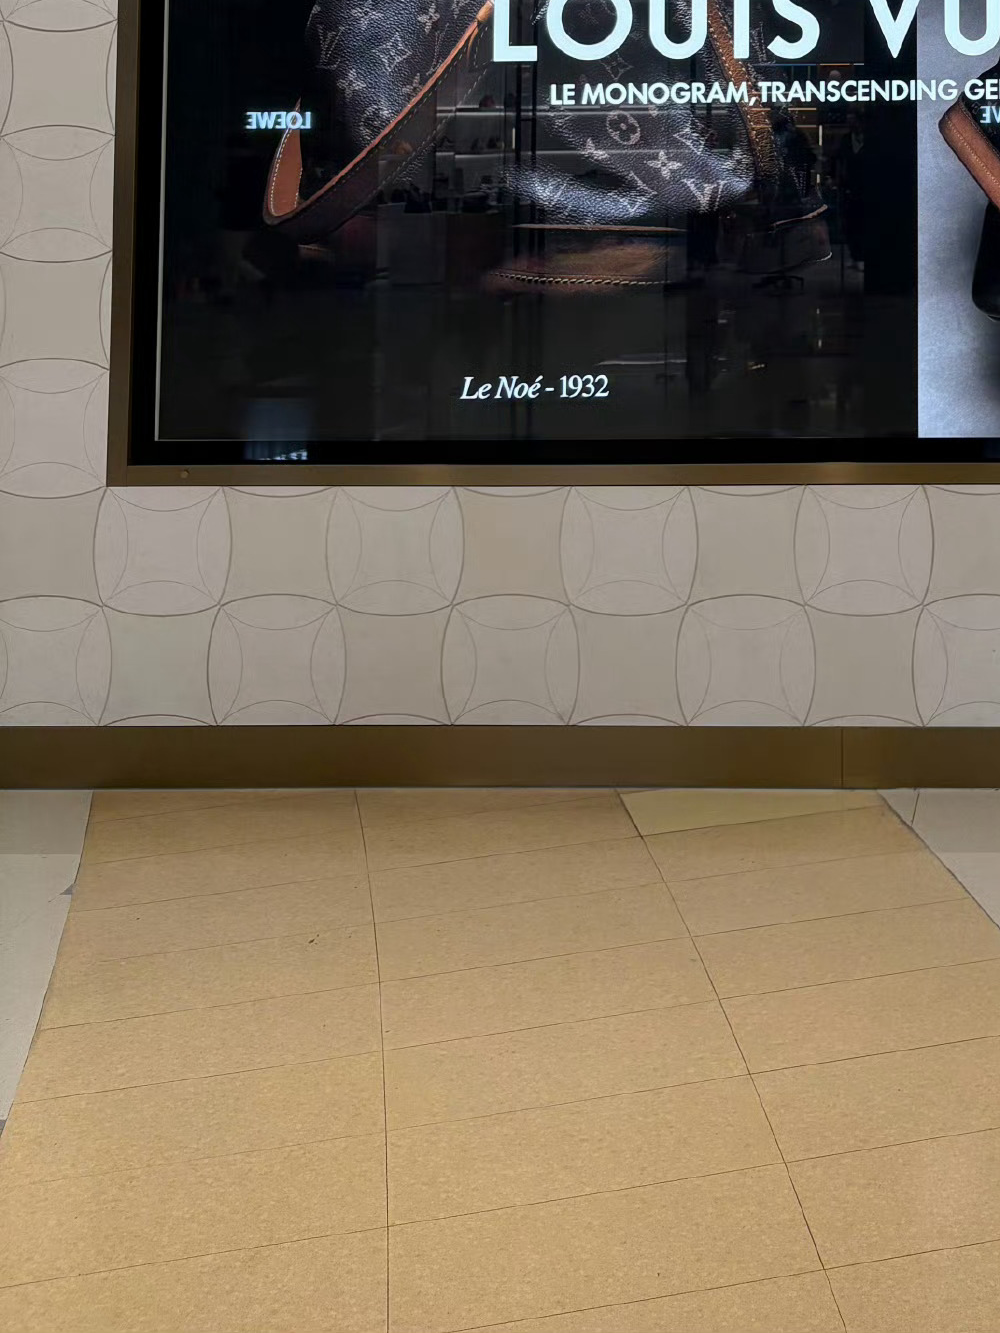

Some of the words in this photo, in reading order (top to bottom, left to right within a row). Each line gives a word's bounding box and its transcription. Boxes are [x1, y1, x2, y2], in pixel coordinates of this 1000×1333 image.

[550, 83, 575, 104] LE
[460, 375, 492, 399] Le
[494, 374, 543, 399] Noé
[559, 374, 610, 398] 1932
